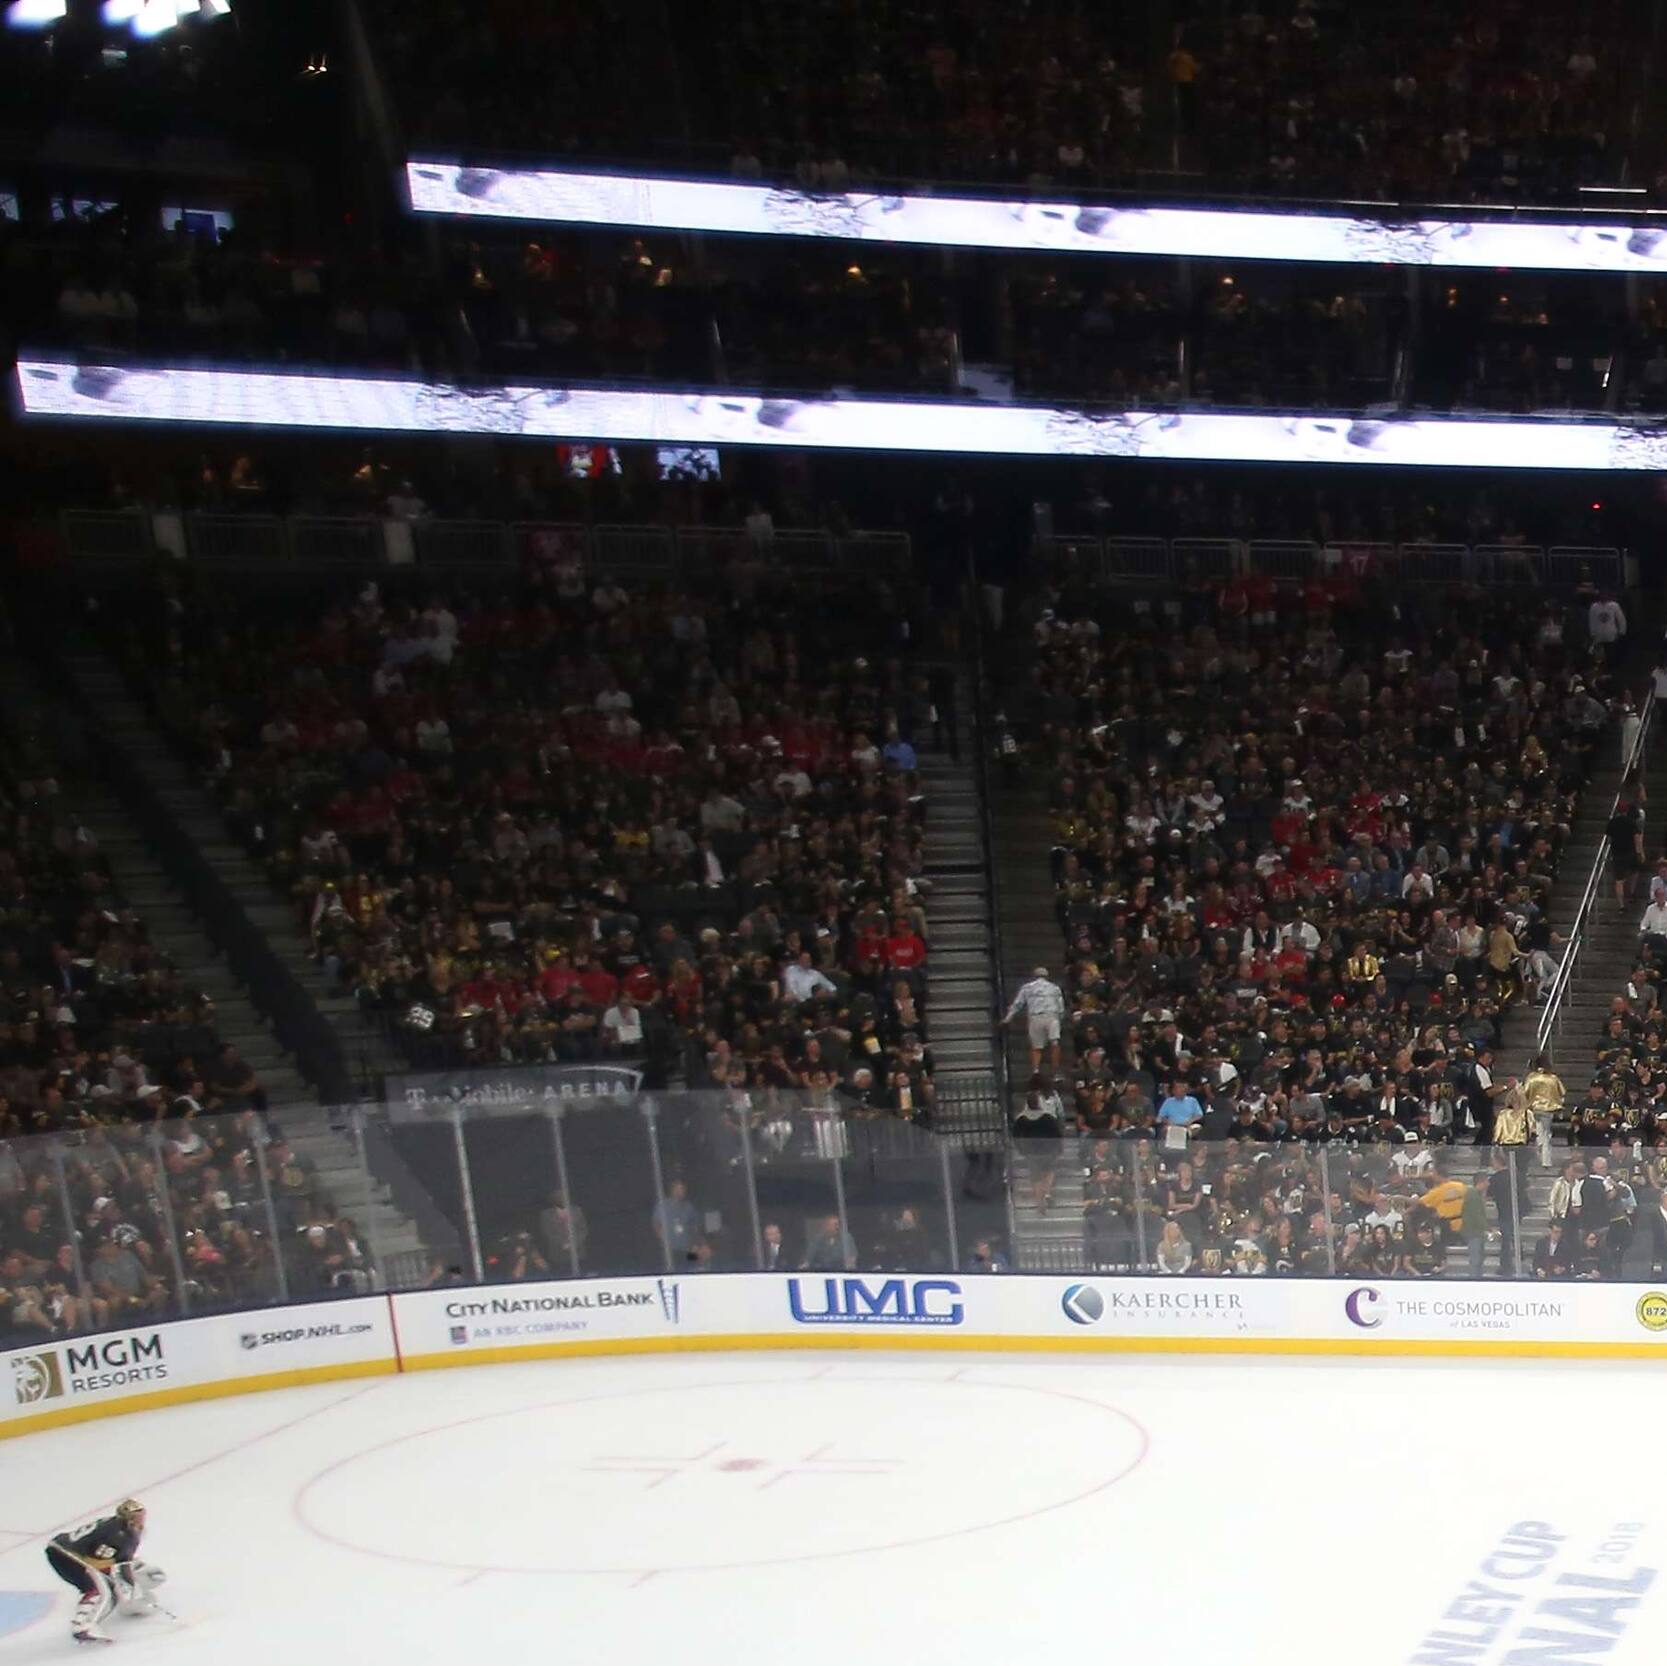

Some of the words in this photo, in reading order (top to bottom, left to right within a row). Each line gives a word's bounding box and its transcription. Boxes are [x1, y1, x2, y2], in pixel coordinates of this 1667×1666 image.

[492, 1295, 595, 1314] NATIONAL
[787, 1278, 964, 1325] UMC
[1112, 1292, 1243, 1309] KAERCHER
[1396, 1300, 1428, 1316] THE
[1433, 1301, 1561, 1317] COSMOPOLITAN
[1113, 1310, 1244, 1319] INSURANCE
[1646, 1306, 1667, 1317] 872
[525, 1321, 588, 1333] COMPANY
[1461, 1320, 1478, 1328] LAS
[1481, 1320, 1510, 1329] VEGAS
[66, 1334, 163, 1374] MGM
[72, 1364, 168, 1393] RESORTS
[1479, 1520, 1567, 1579] CUP
